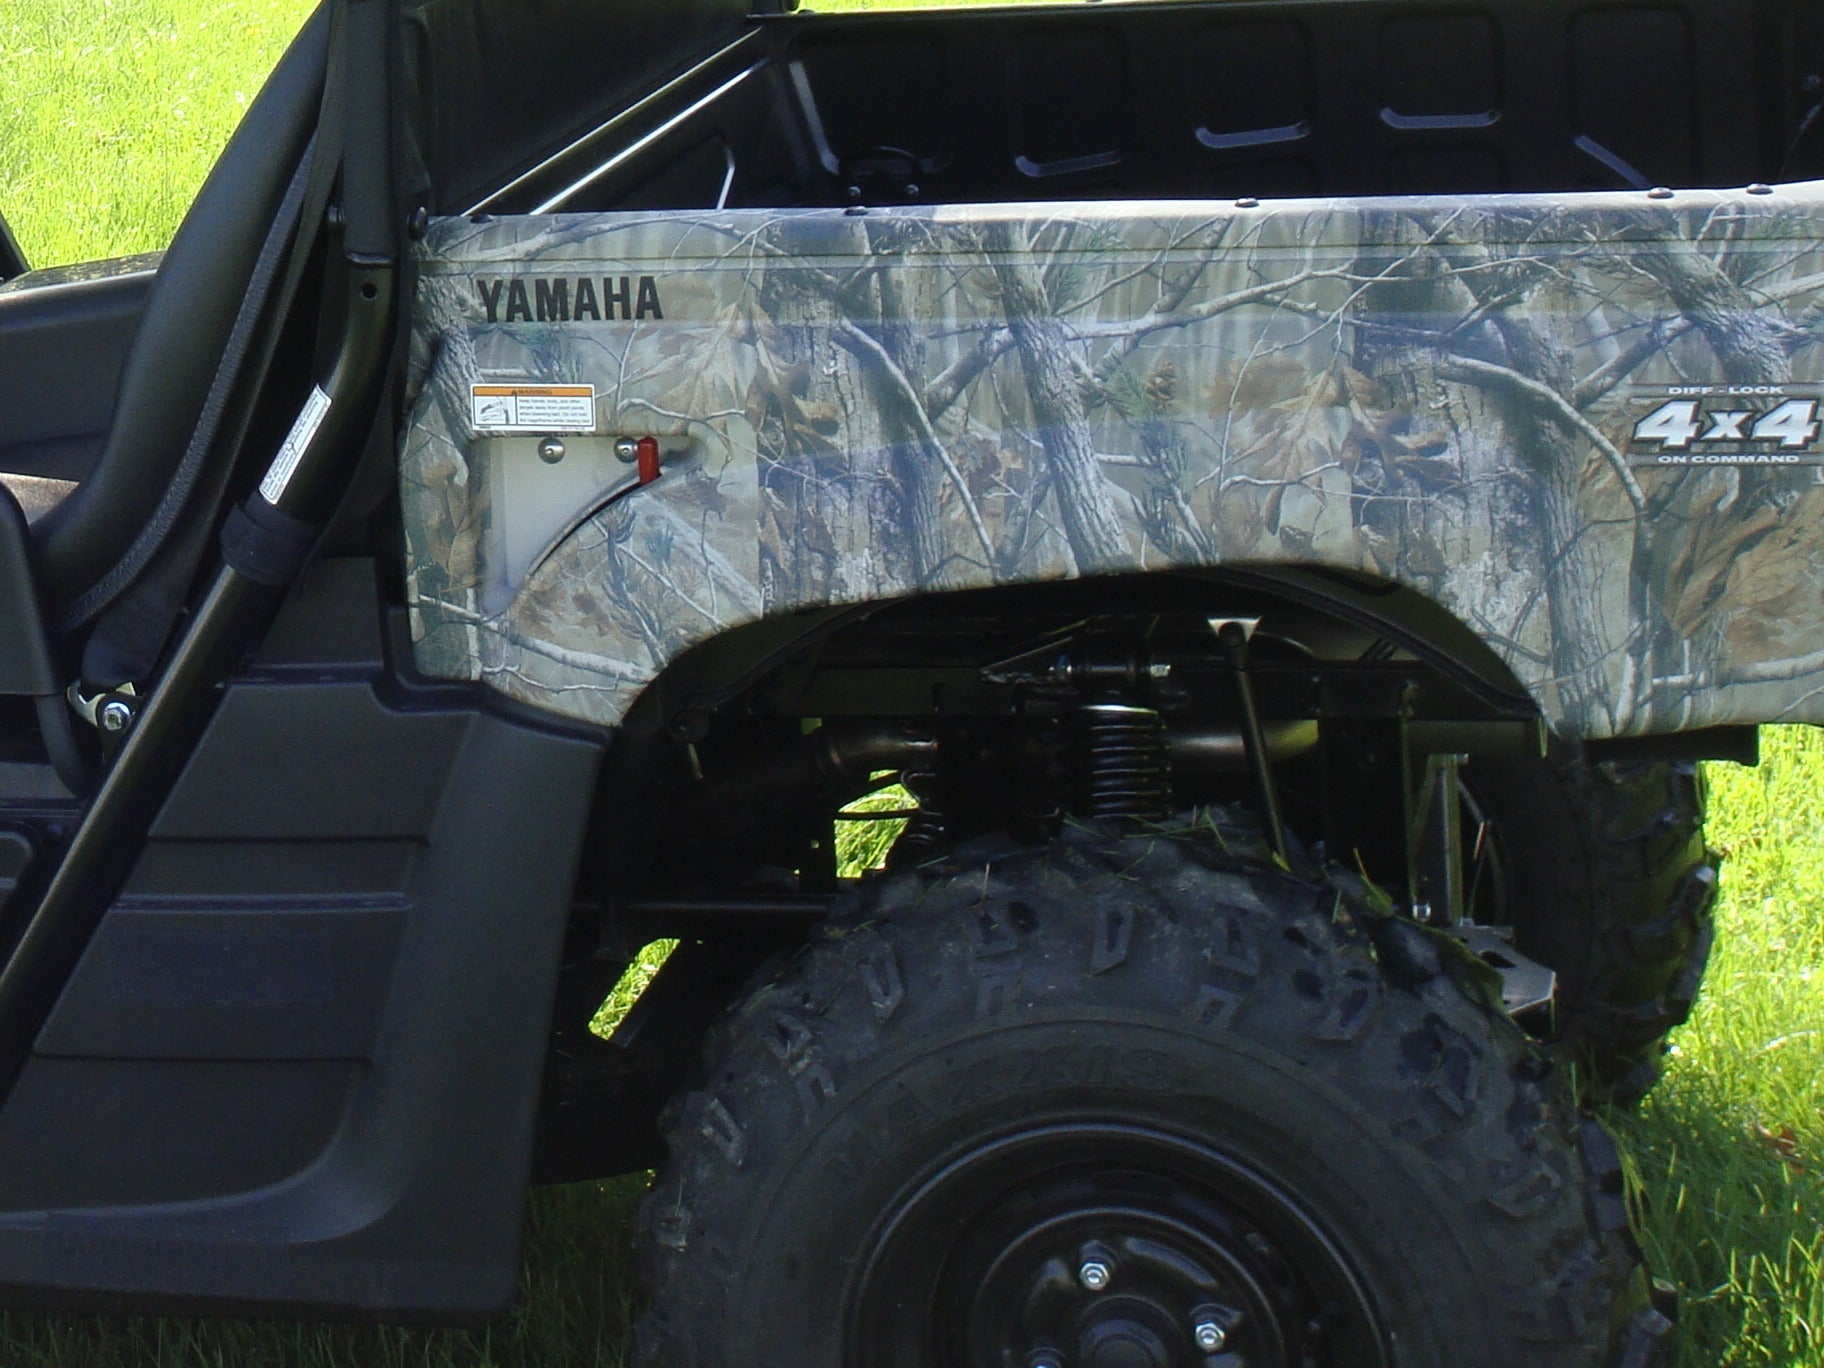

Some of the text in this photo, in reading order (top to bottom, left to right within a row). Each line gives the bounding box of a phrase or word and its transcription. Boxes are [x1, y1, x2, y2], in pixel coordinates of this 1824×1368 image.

[477, 275, 664, 324] YAMAHA
[1632, 397, 1822, 449] 4x4
[1657, 455, 1800, 464] ON COMMAND
